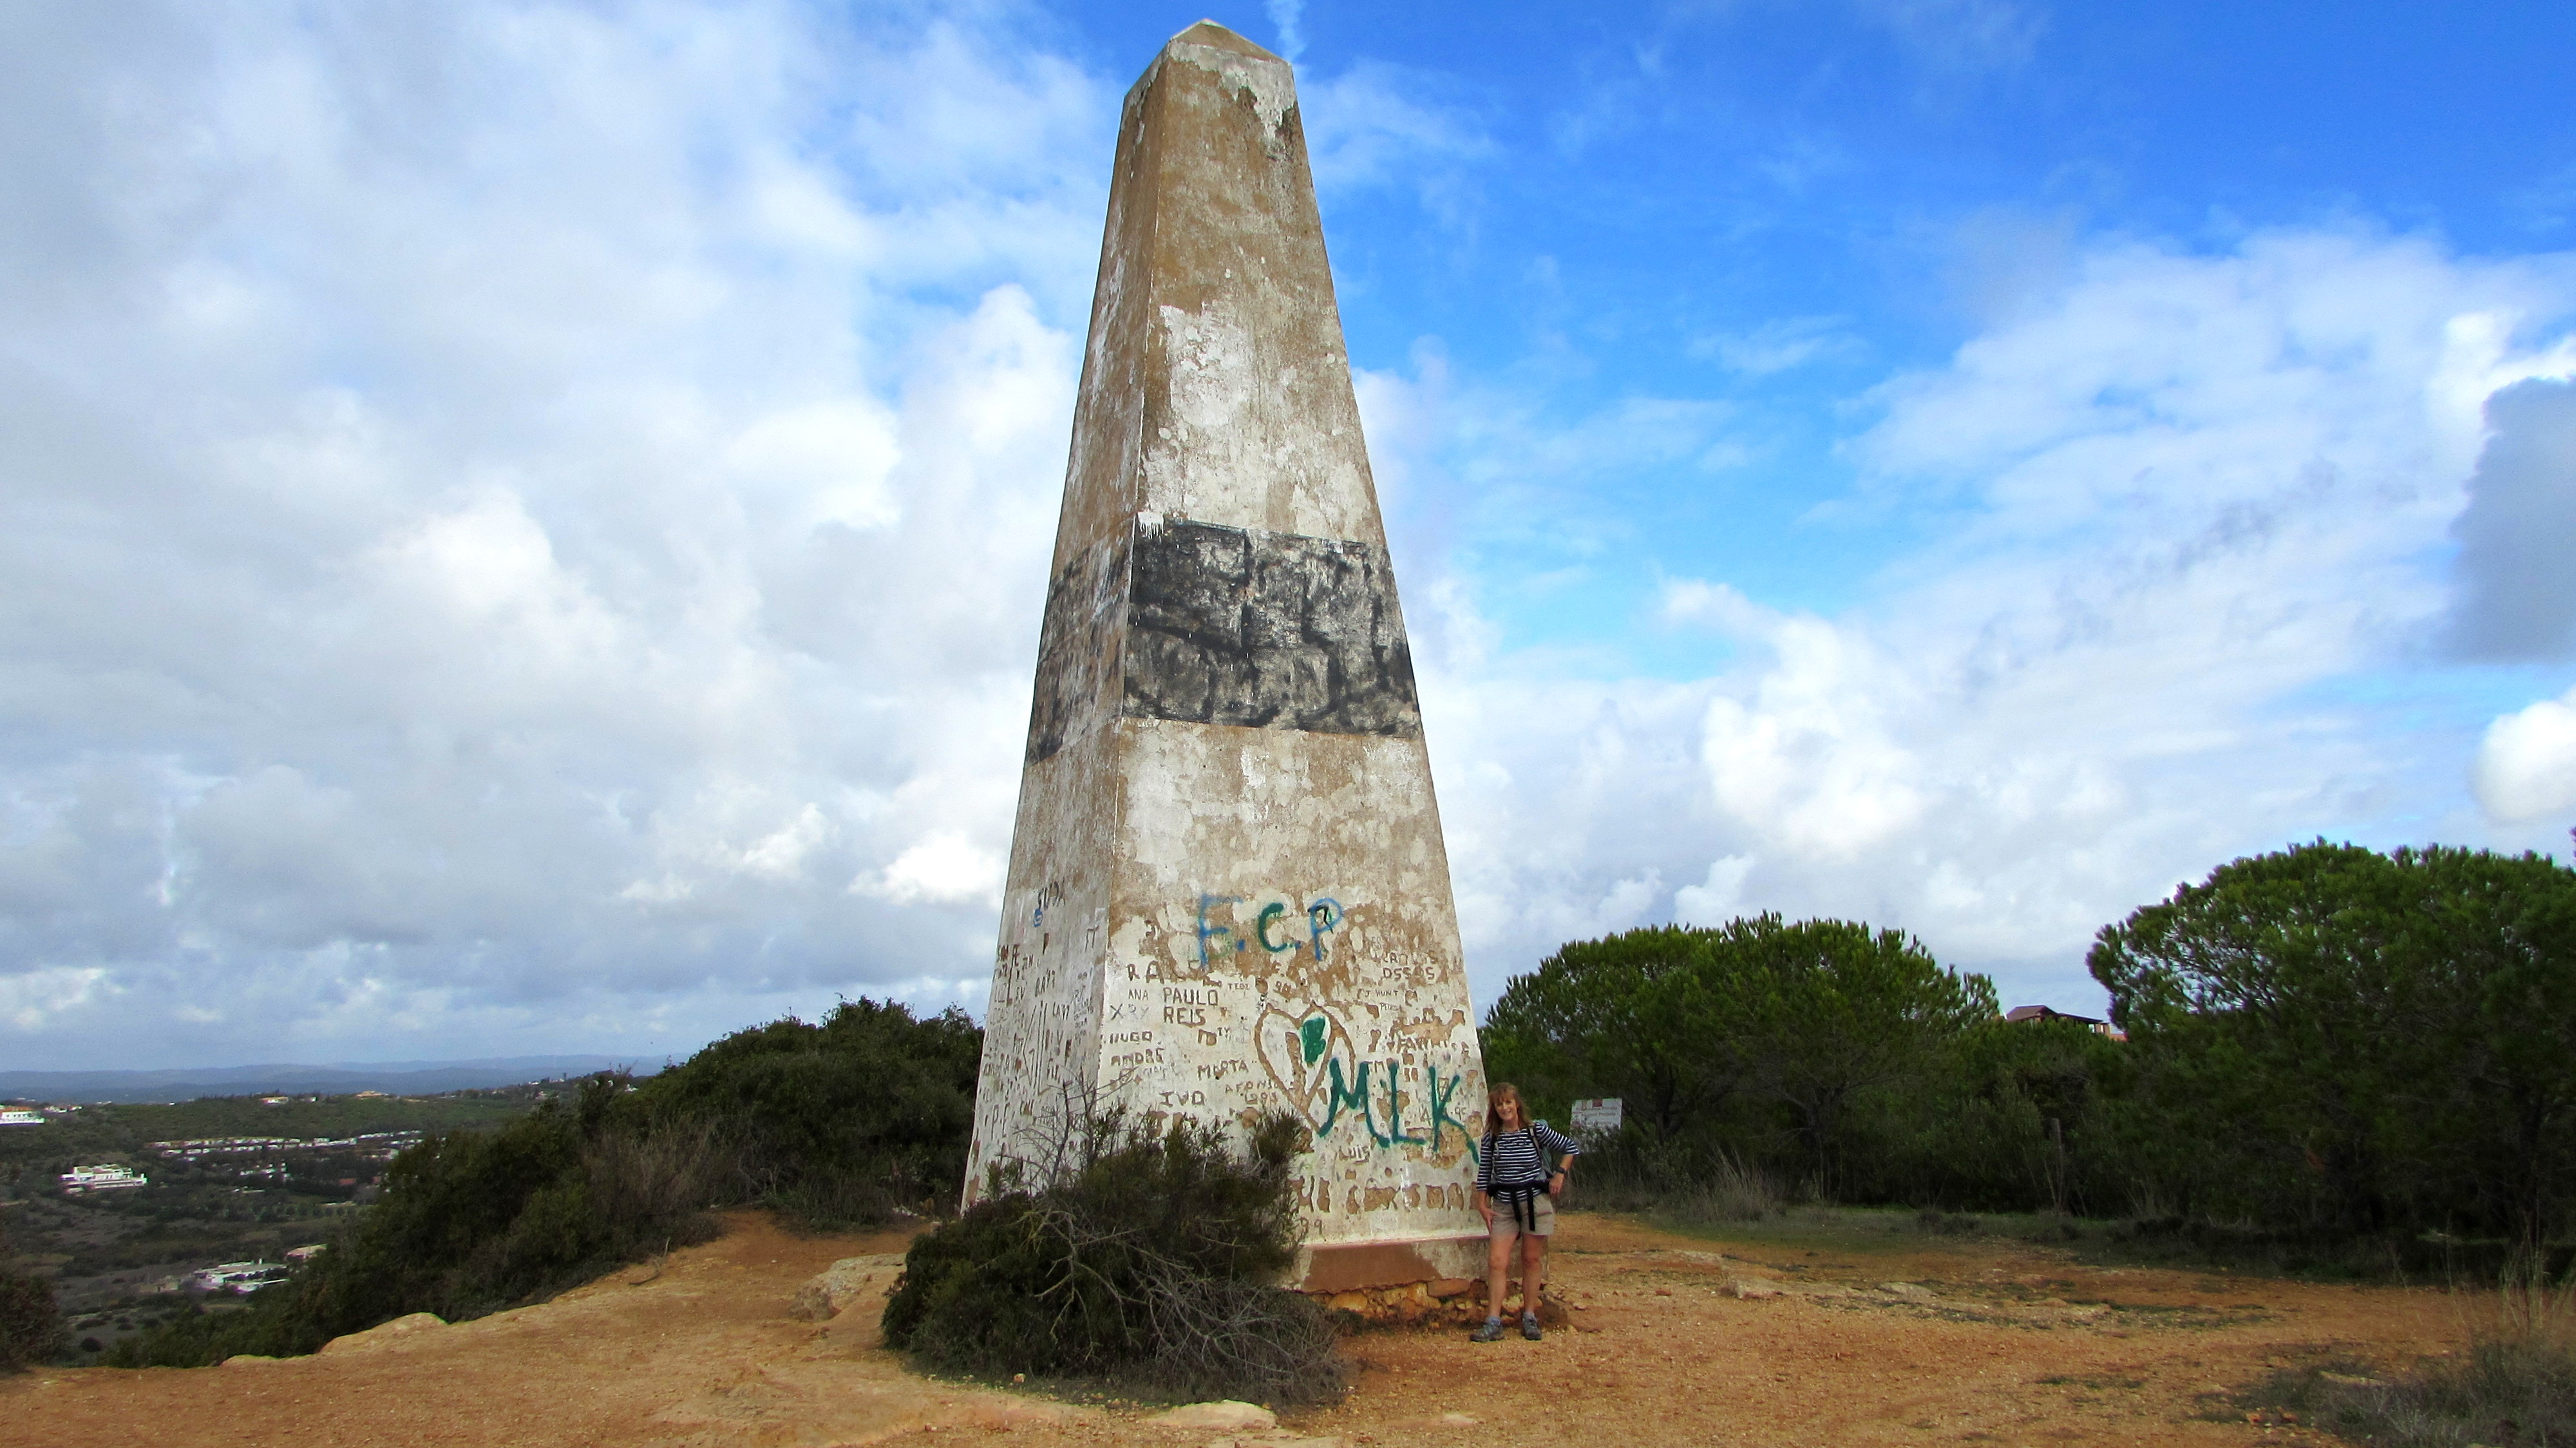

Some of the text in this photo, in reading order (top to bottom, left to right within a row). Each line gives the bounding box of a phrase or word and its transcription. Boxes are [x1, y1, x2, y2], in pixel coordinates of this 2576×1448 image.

[1128, 988, 1149, 1001] ANA
[1162, 987, 1218, 1006] PAULO
[1163, 1006, 1206, 1028] REIS
[1109, 1031, 1153, 1044] HUGO
[1197, 1060, 1249, 1081] MARTA
[1159, 1090, 1205, 1108] IVO
[1319, 1057, 1480, 1165] MLK
